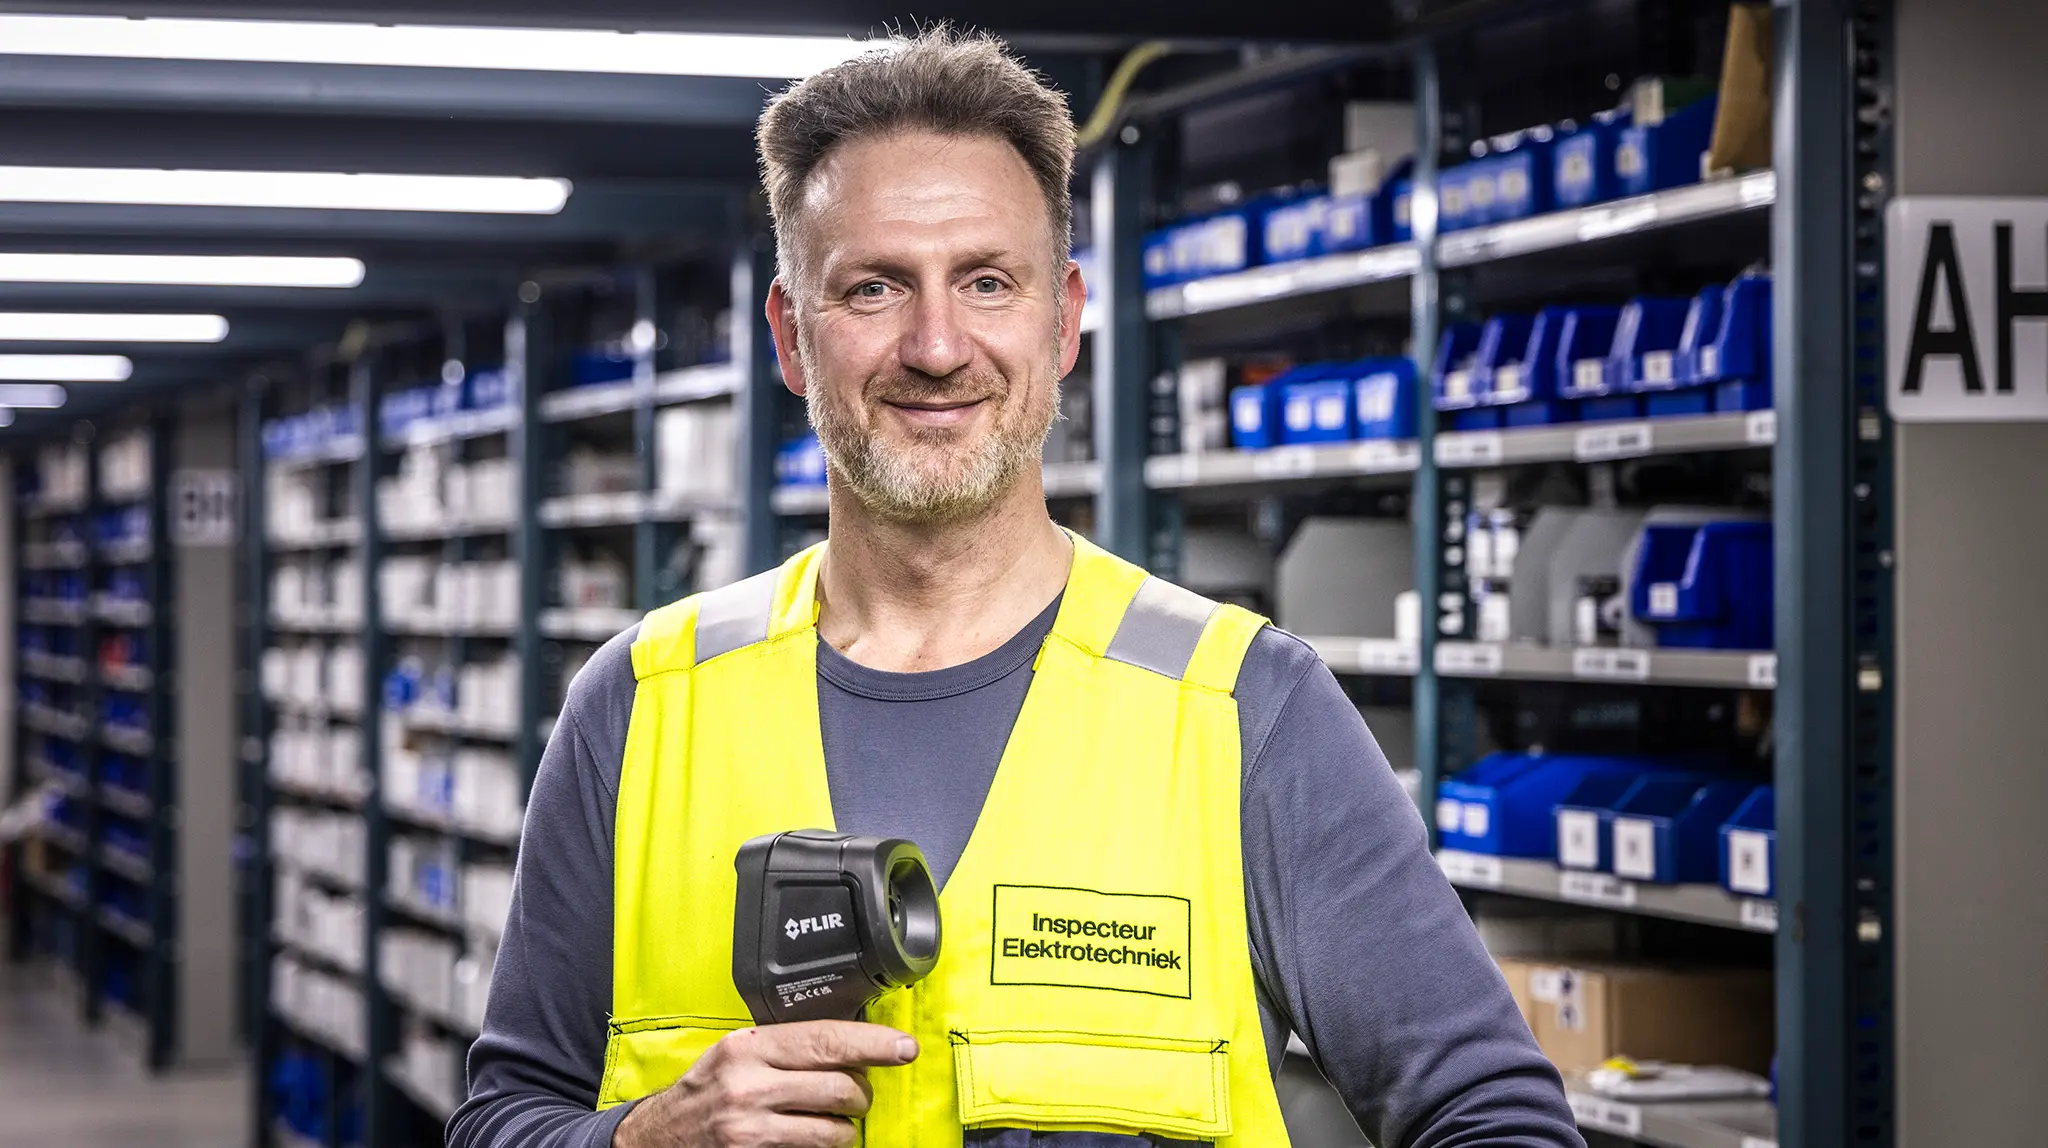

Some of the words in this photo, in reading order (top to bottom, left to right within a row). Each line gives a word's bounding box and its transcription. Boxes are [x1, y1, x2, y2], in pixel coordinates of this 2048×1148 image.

[1901, 220, 2048, 394] AH
[800, 912, 845, 934] FLIR
[1032, 912, 1157, 940] Inspecteur
[1002, 937, 1182, 970] Elektrotechniek
